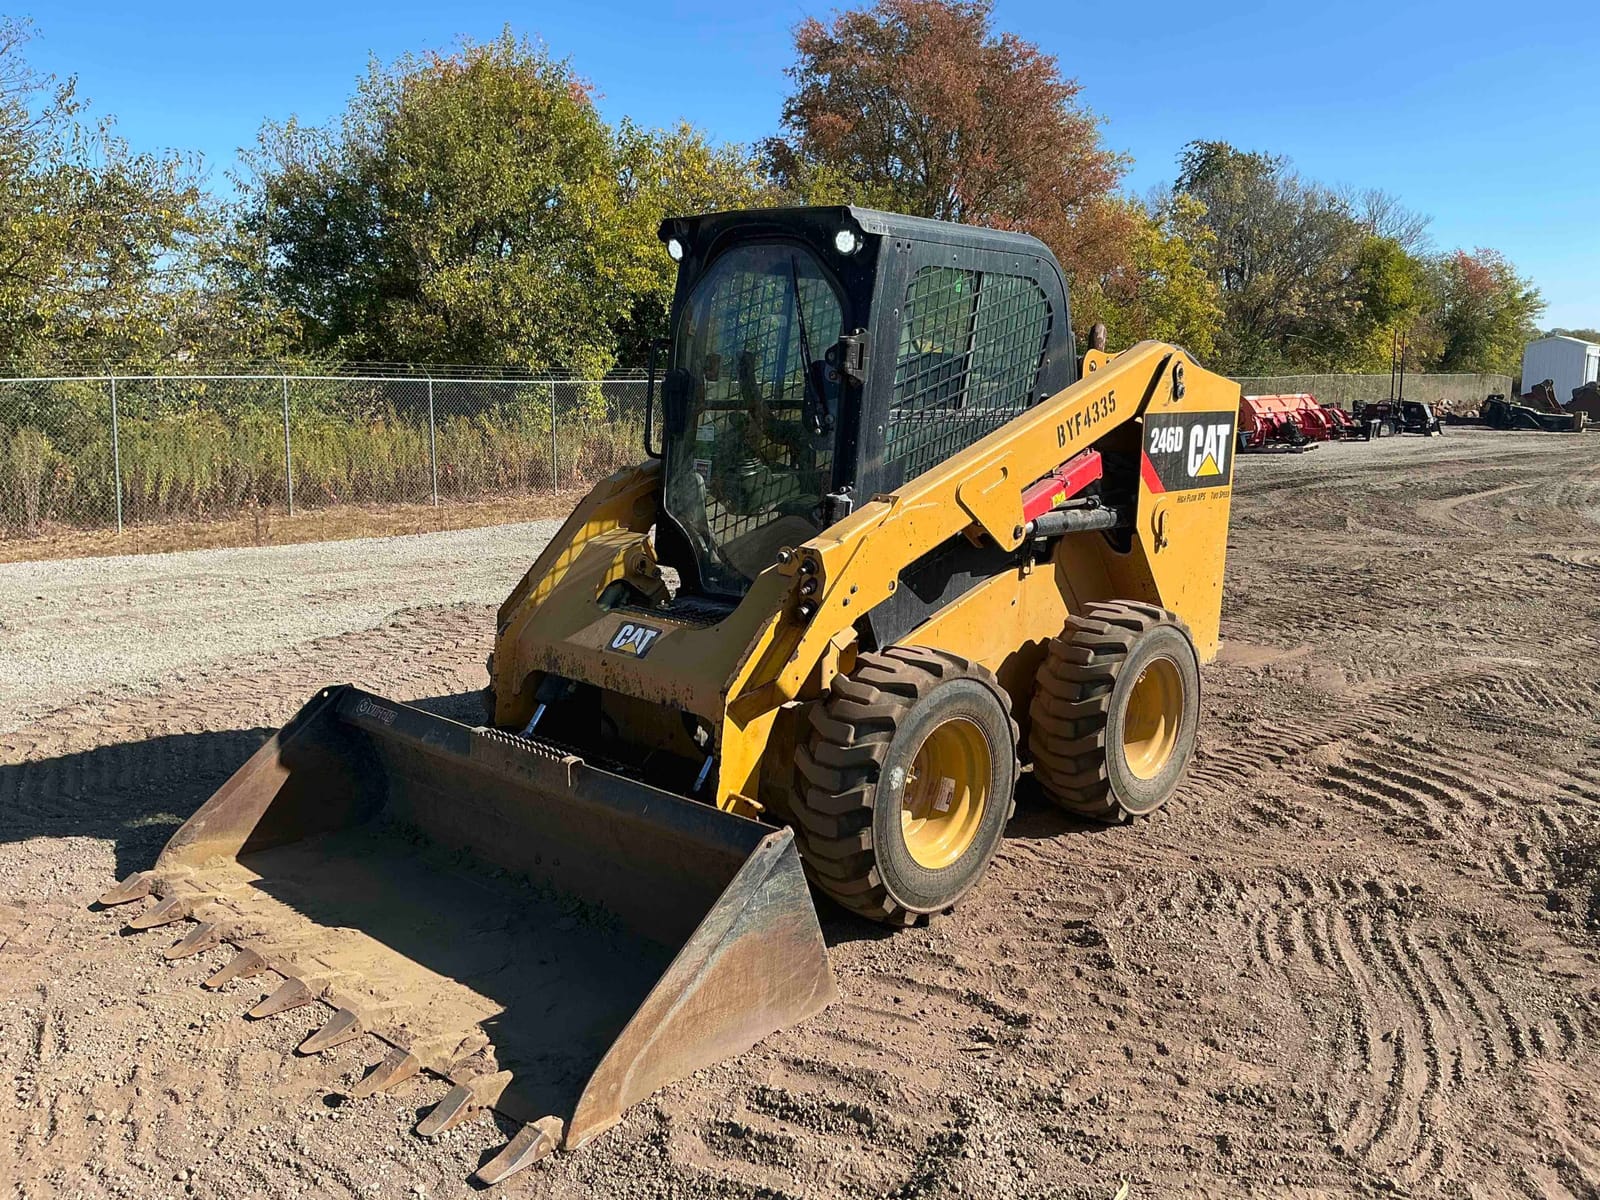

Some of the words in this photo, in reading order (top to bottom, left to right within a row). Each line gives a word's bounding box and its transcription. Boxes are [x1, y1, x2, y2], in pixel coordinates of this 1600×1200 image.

[1057, 390, 1116, 448] BYF4335
[1150, 426, 1184, 454] 246D
[1187, 424, 1231, 477] CAT
[611, 624, 658, 655] CAT
